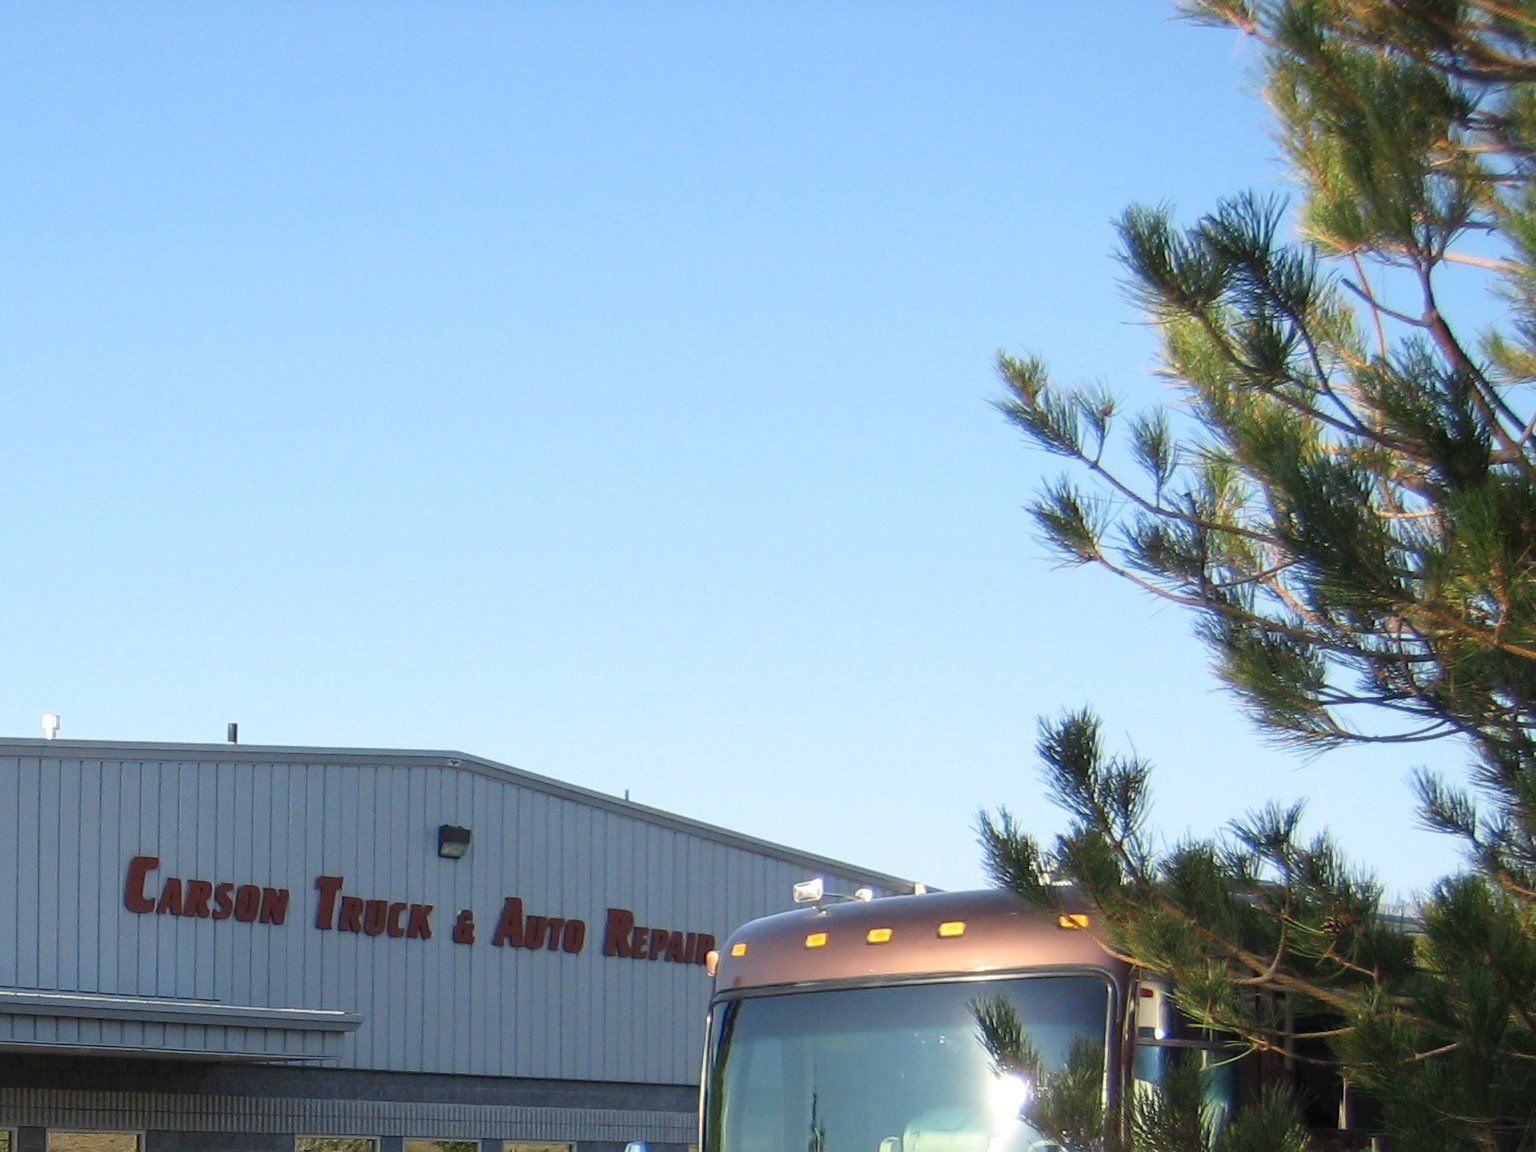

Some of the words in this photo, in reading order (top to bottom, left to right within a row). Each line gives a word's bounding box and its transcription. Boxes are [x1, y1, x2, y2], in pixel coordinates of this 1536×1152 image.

[124, 856, 289, 925] CARSON
[315, 875, 433, 940] TRUCK
[452, 909, 475, 945] &
[492, 897, 585, 953] AUTO
[603, 908, 714, 966] REPAIR
